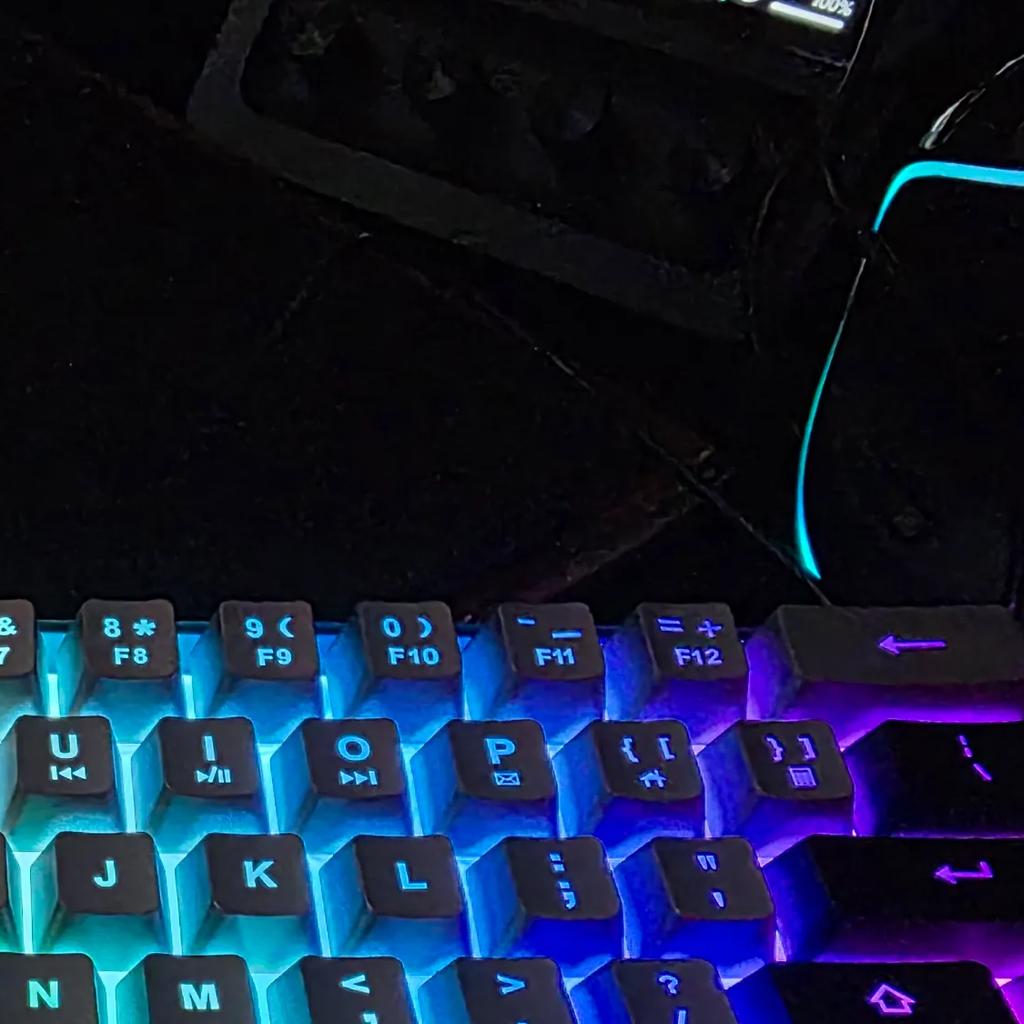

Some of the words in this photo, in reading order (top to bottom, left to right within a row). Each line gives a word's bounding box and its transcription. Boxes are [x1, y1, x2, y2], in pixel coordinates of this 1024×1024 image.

[103, 617, 121, 638] 8
[245, 617, 264, 639] 9
[382, 616, 402, 638] 0
[114, 647, 149, 665] F8
[256, 647, 292, 666] F9
[387, 646, 440, 666] F10
[535, 647, 575, 666] F11
[674, 647, 723, 666] F12
[49, 733, 79, 759] U
[203, 735, 216, 762] I
[336, 735, 371, 762] O
[484, 737, 516, 765] P
[93, 859, 117, 888] J
[243, 860, 278, 889] K
[395, 861, 428, 890] L
[28, 980, 59, 1009] N
[179, 983, 220, 1010] M
